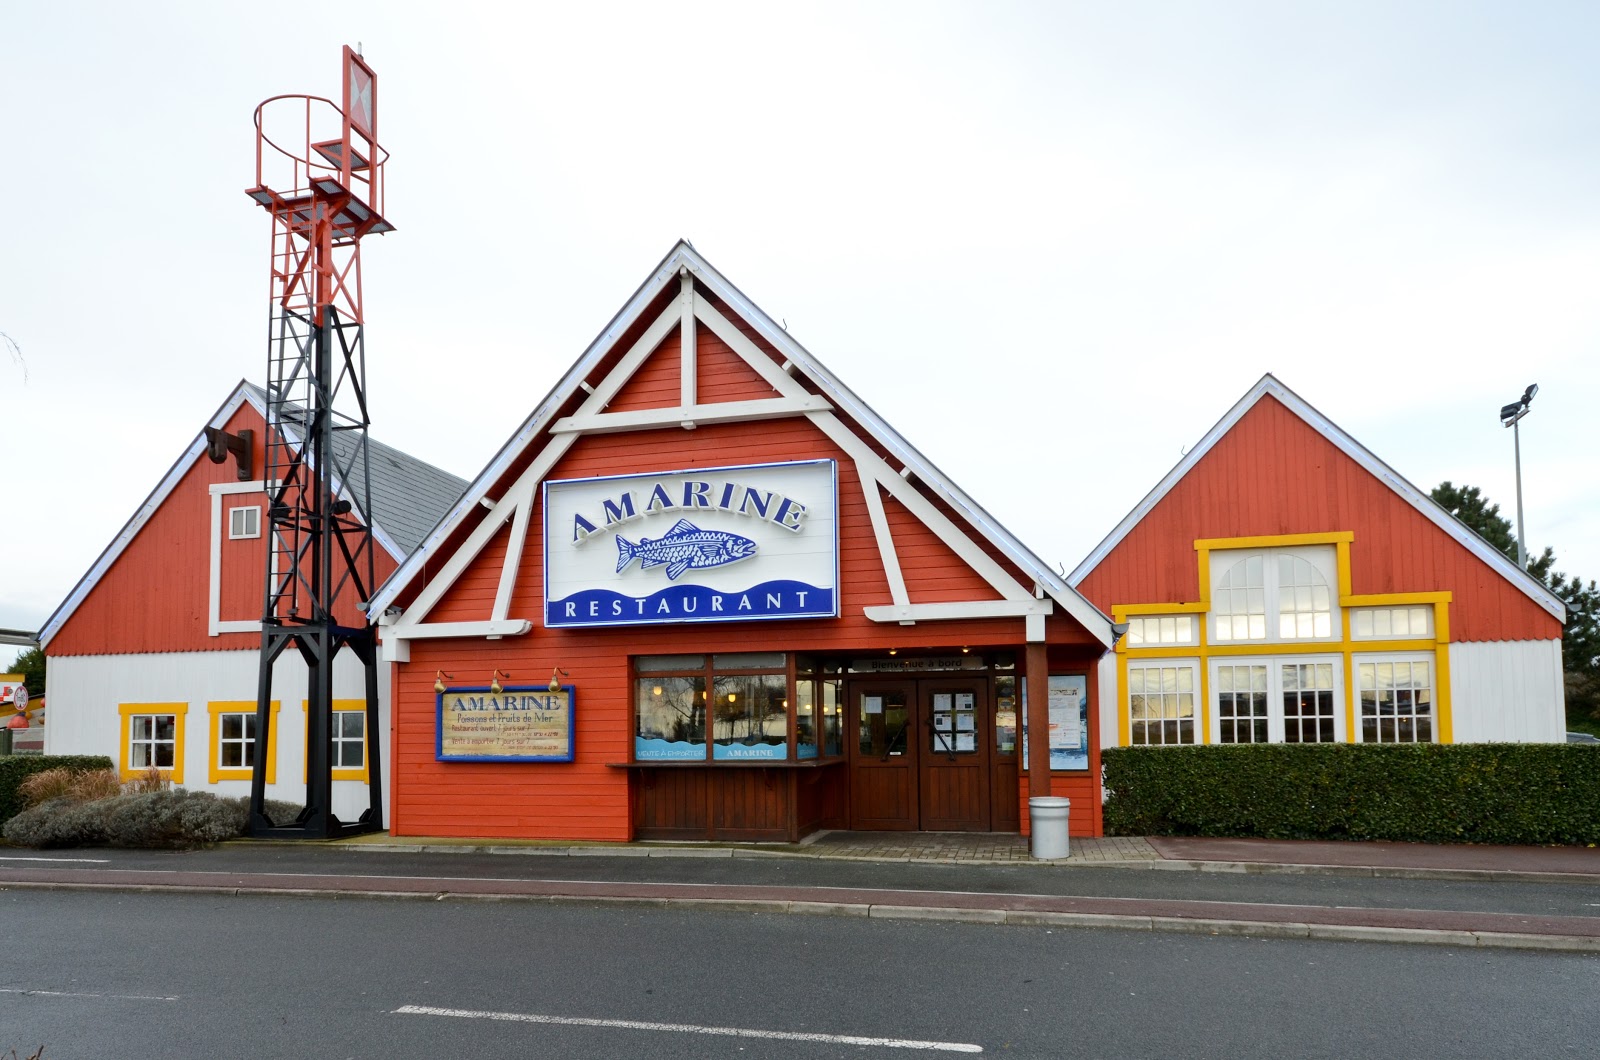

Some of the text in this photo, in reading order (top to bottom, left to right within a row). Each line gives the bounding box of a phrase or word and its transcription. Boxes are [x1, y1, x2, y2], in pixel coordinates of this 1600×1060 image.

[572, 480, 809, 548] AMARINE
[565, 591, 808, 617] RESTAURANT
[871, 659, 924, 669] Bienvenue
[938, 658, 963, 667] bord
[451, 695, 561, 711] AMARINE
[457, 712, 553, 723] Poissons et Fruits de Mer
[451, 724, 479, 732] Restaurant
[502, 724, 517, 732] jours
[471, 738, 494, 746] emporter
[726, 749, 774, 757] AMARINE
